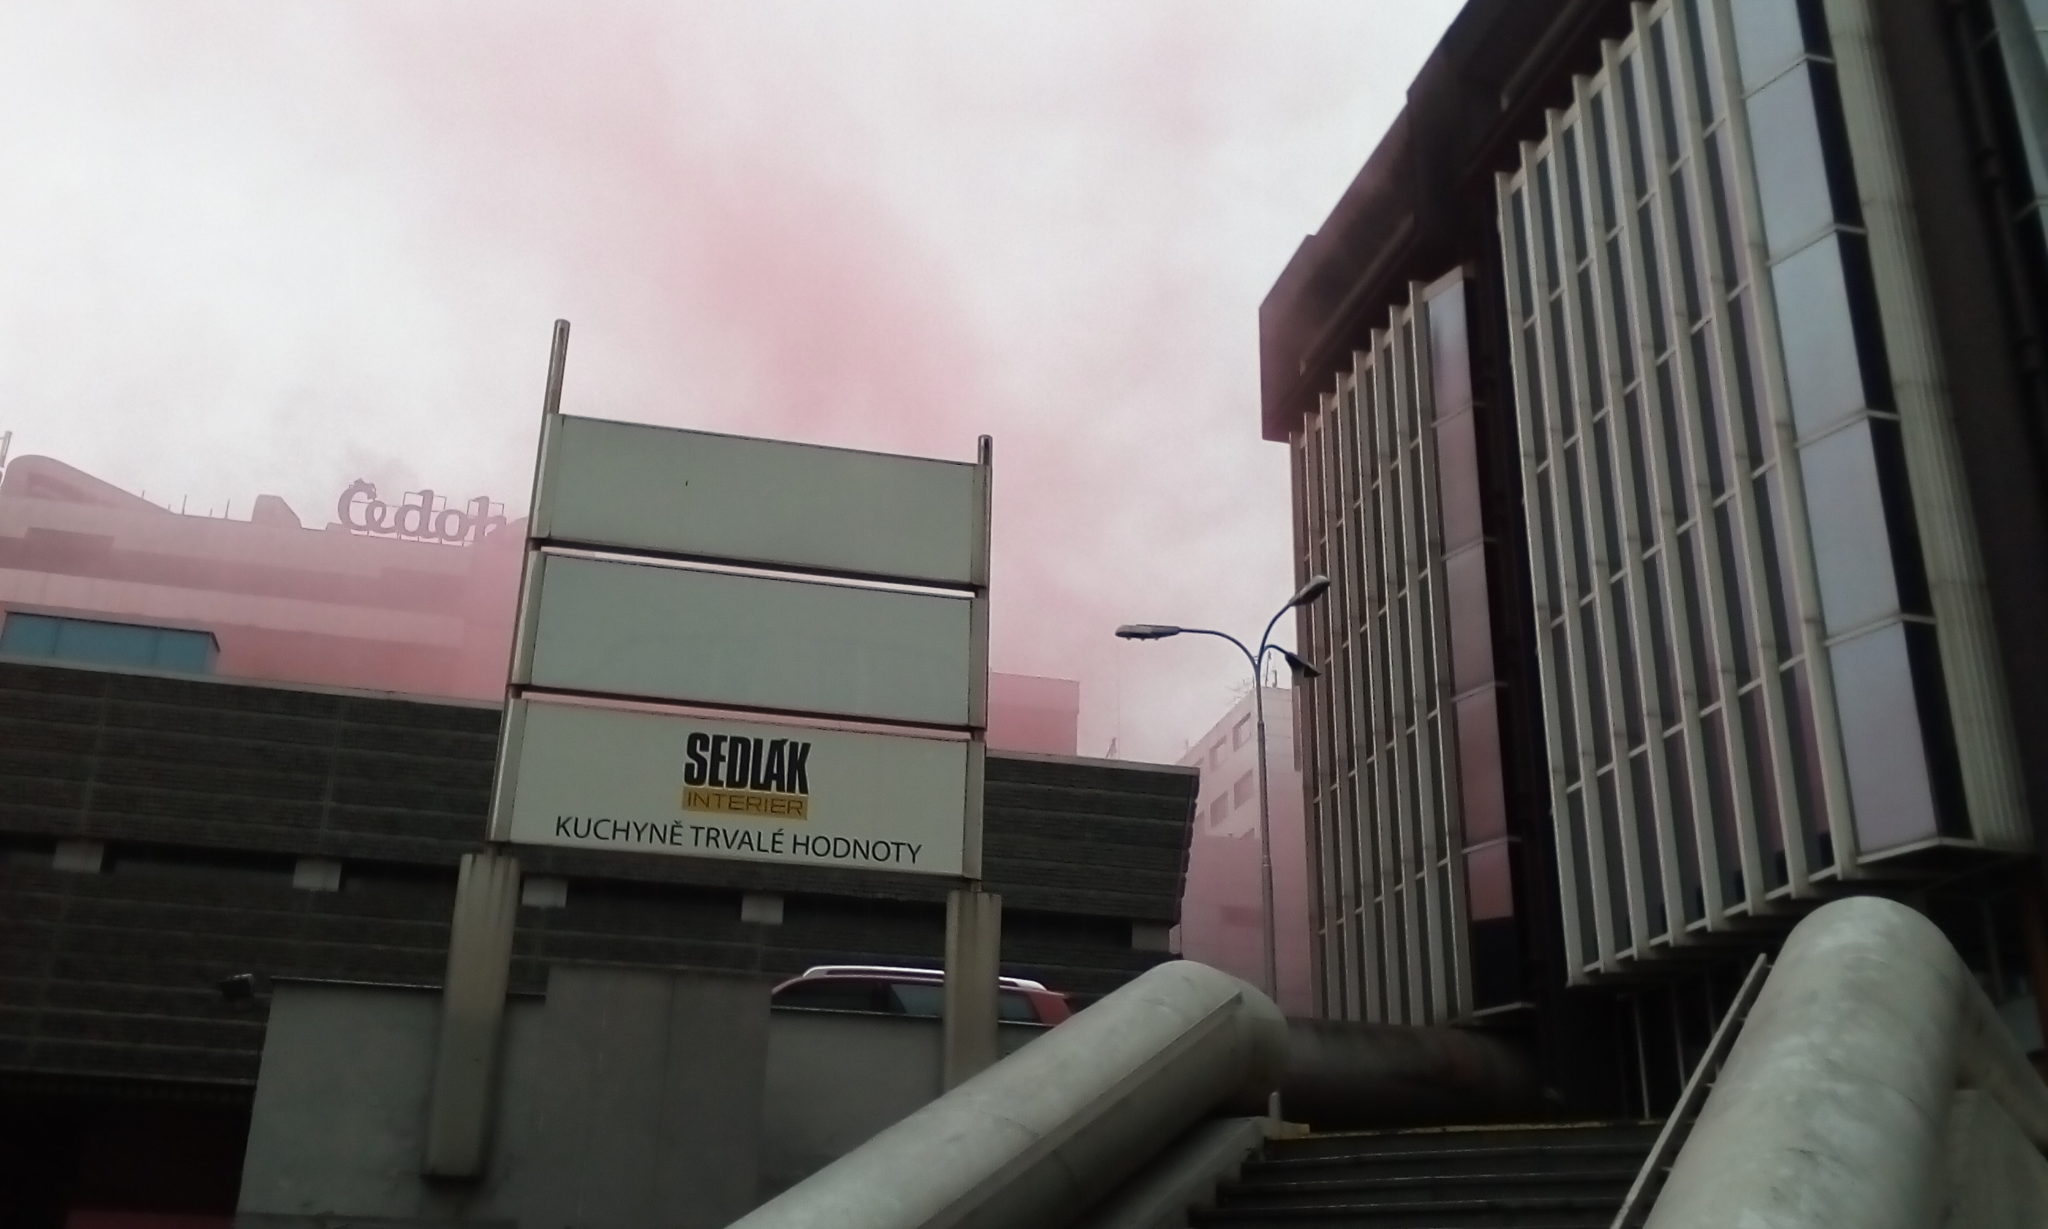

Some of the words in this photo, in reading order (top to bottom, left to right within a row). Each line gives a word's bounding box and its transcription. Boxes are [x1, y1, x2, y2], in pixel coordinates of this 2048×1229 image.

[683, 732, 811, 795] SEDLÁK
[686, 791, 804, 816] INTERIER
[555, 815, 683, 846] KUCHYNĚ
[690, 827, 784, 854] TRVALÉ
[792, 834, 922, 864] HODNOTY
